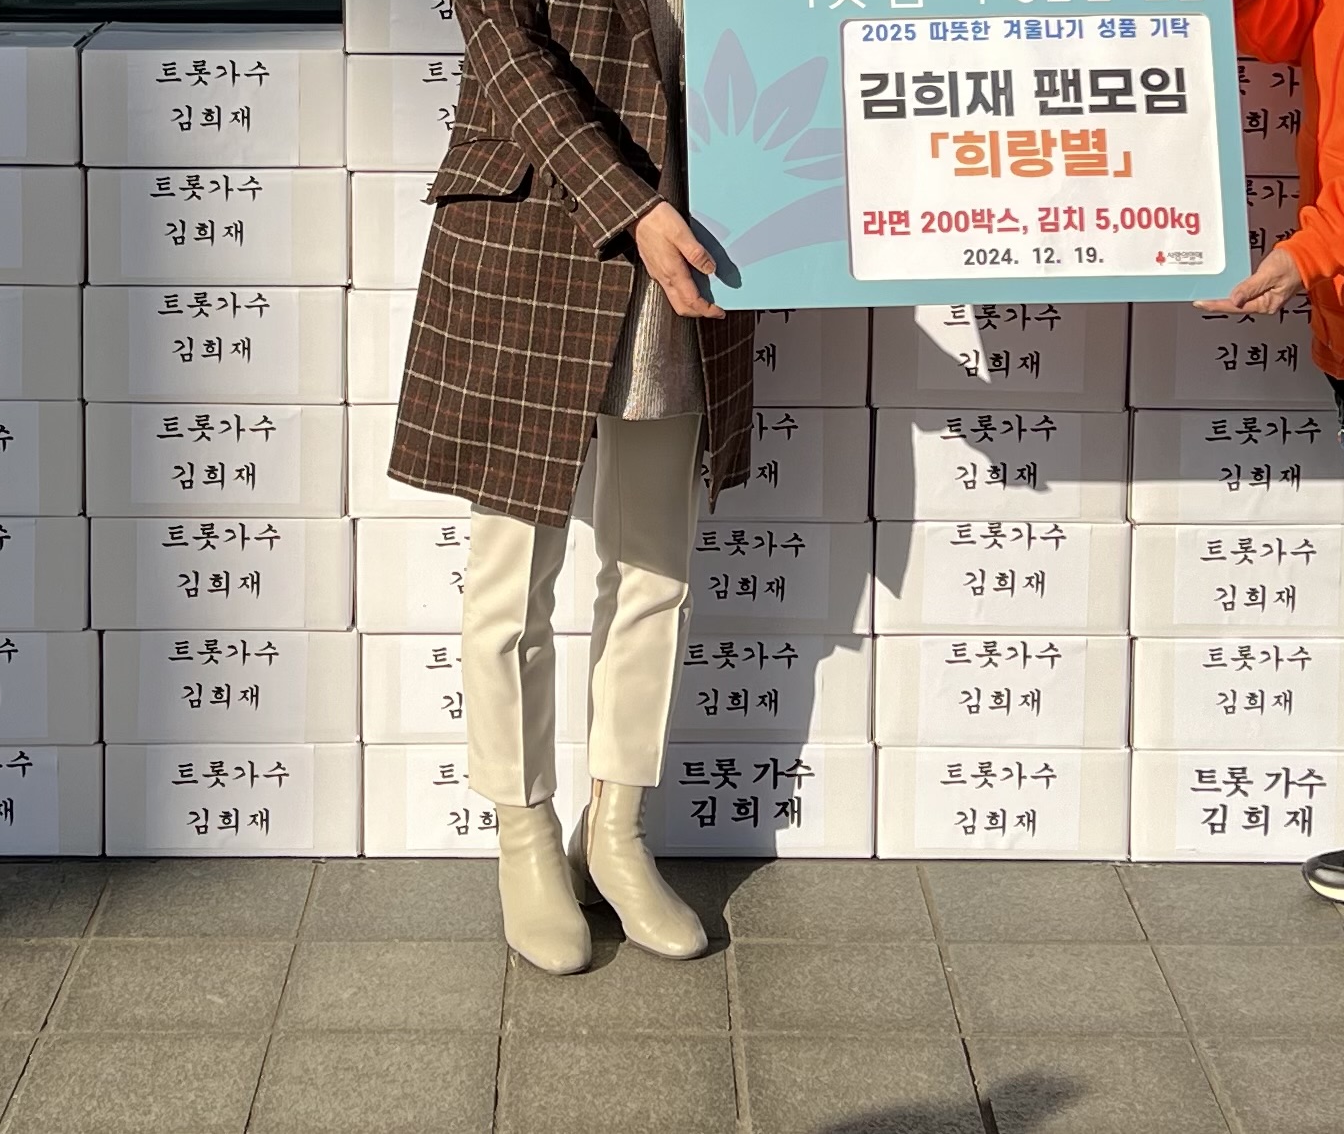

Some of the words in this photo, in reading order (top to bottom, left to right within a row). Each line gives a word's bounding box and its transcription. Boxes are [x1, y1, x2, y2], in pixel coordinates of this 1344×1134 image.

[861, 22, 917, 43] 2025
[928, 19, 991, 43] 따뜻한
[1003, 18, 1084, 42] 겨울나기
[1097, 18, 1137, 40] 성품
[1150, 17, 1190, 40] 기탁
[858, 70, 1015, 120] 김희재
[1032, 67, 1189, 117] 팬모임
[862, 211, 911, 238] 라면
[920, 207, 1029, 236] 200박스,
[1037, 207, 1086, 234] 김치
[1095, 206, 1201, 237] 5,000kg
[963, 247, 1019, 267] 2024.
[1032, 247, 1062, 266] 12.
[1074, 245, 1105, 265] 19.
[156, 413, 277, 443] 트롯가수
[172, 461, 256, 491] 김희재
[695, 529, 806, 559] 트롯가수
[949, 520, 1067, 551] 트롯가수
[1199, 537, 1317, 565] 트롯가수
[964, 568, 1046, 598] 김희재
[1215, 584, 1296, 612] 김희재
